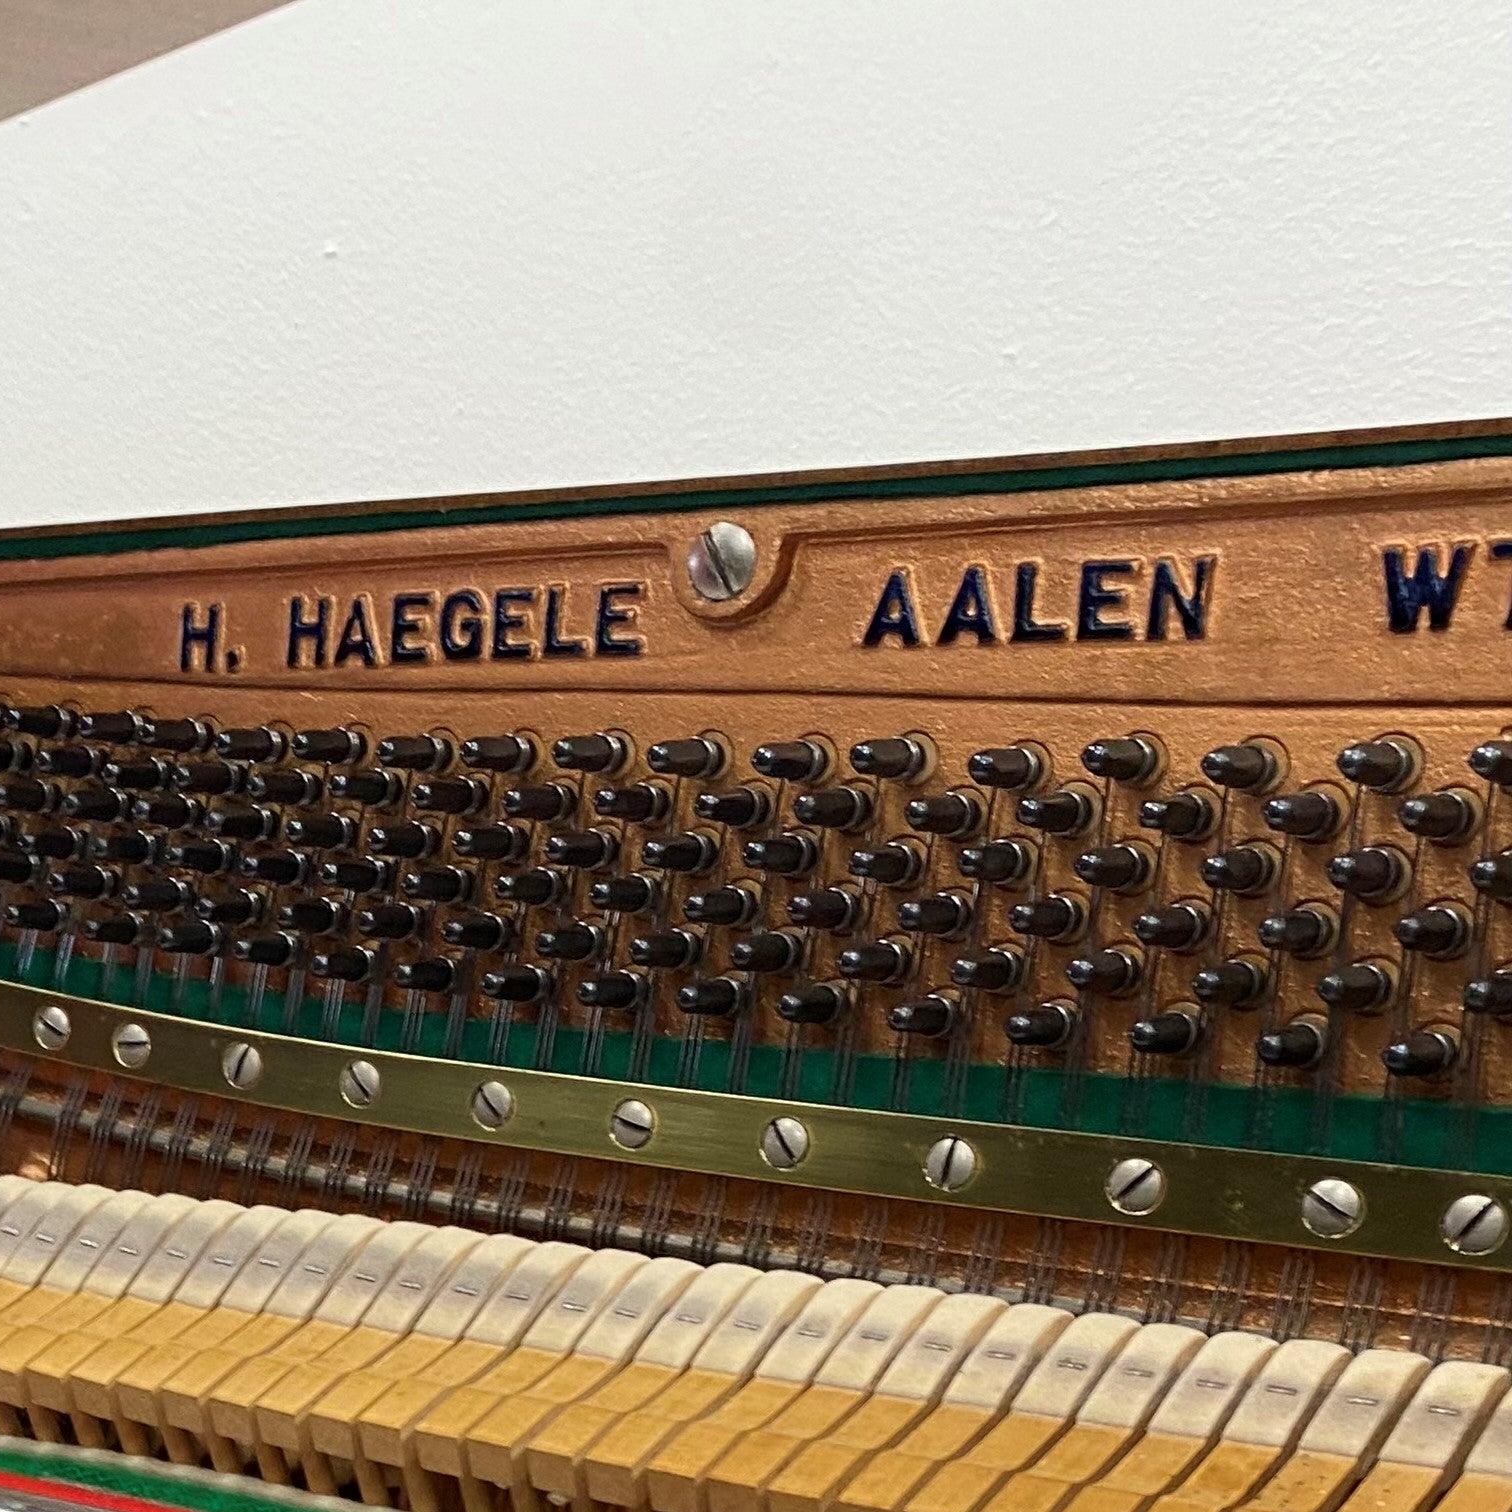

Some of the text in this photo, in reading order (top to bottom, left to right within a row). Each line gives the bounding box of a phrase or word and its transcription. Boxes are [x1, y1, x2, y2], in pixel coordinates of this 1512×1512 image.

[180, 601, 245, 673] H.
[287, 581, 647, 669] HAEGELE
[860, 553, 1221, 648] AALEN
